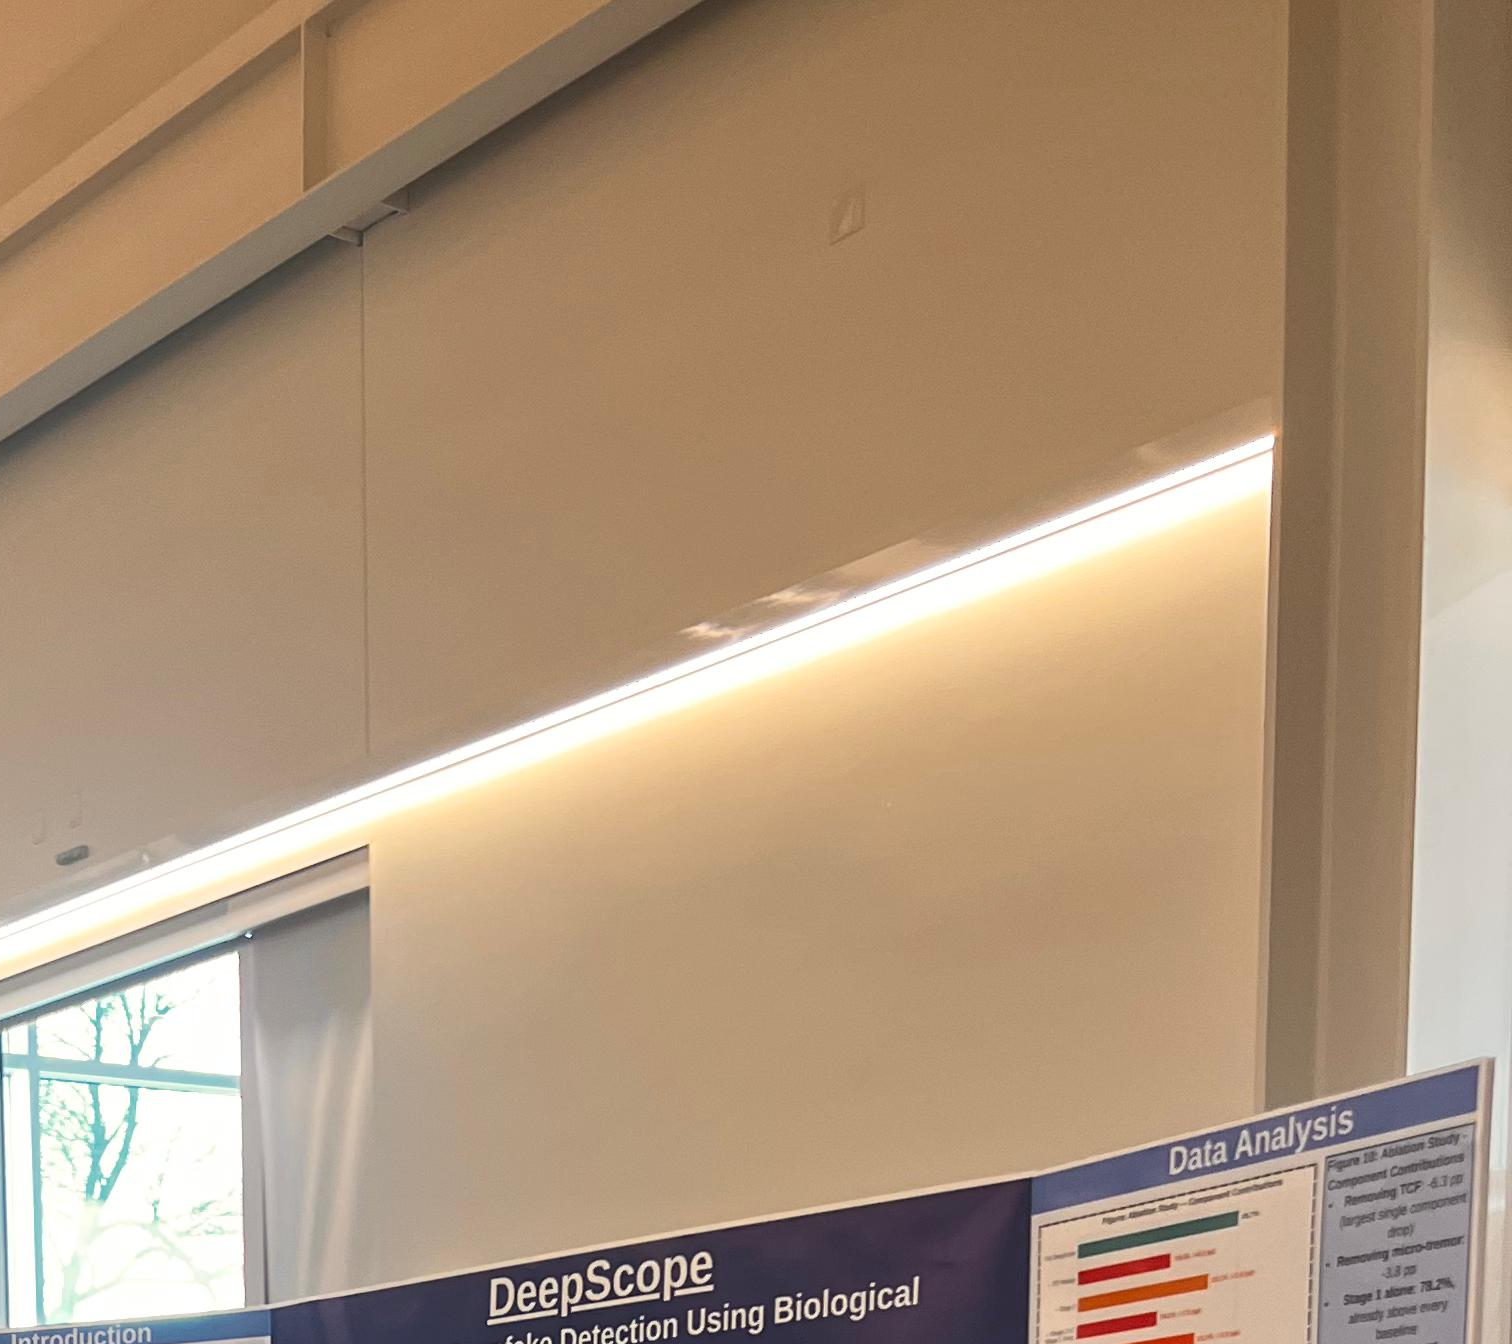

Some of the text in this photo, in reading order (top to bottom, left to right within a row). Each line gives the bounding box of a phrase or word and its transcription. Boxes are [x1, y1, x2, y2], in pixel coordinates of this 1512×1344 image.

[1168, 1105, 1355, 1176] Data Analysis
[487, 1248, 714, 1319] DeepScope
[686, 1300, 766, 1337] Using
[774, 1276, 921, 1326] Biological
